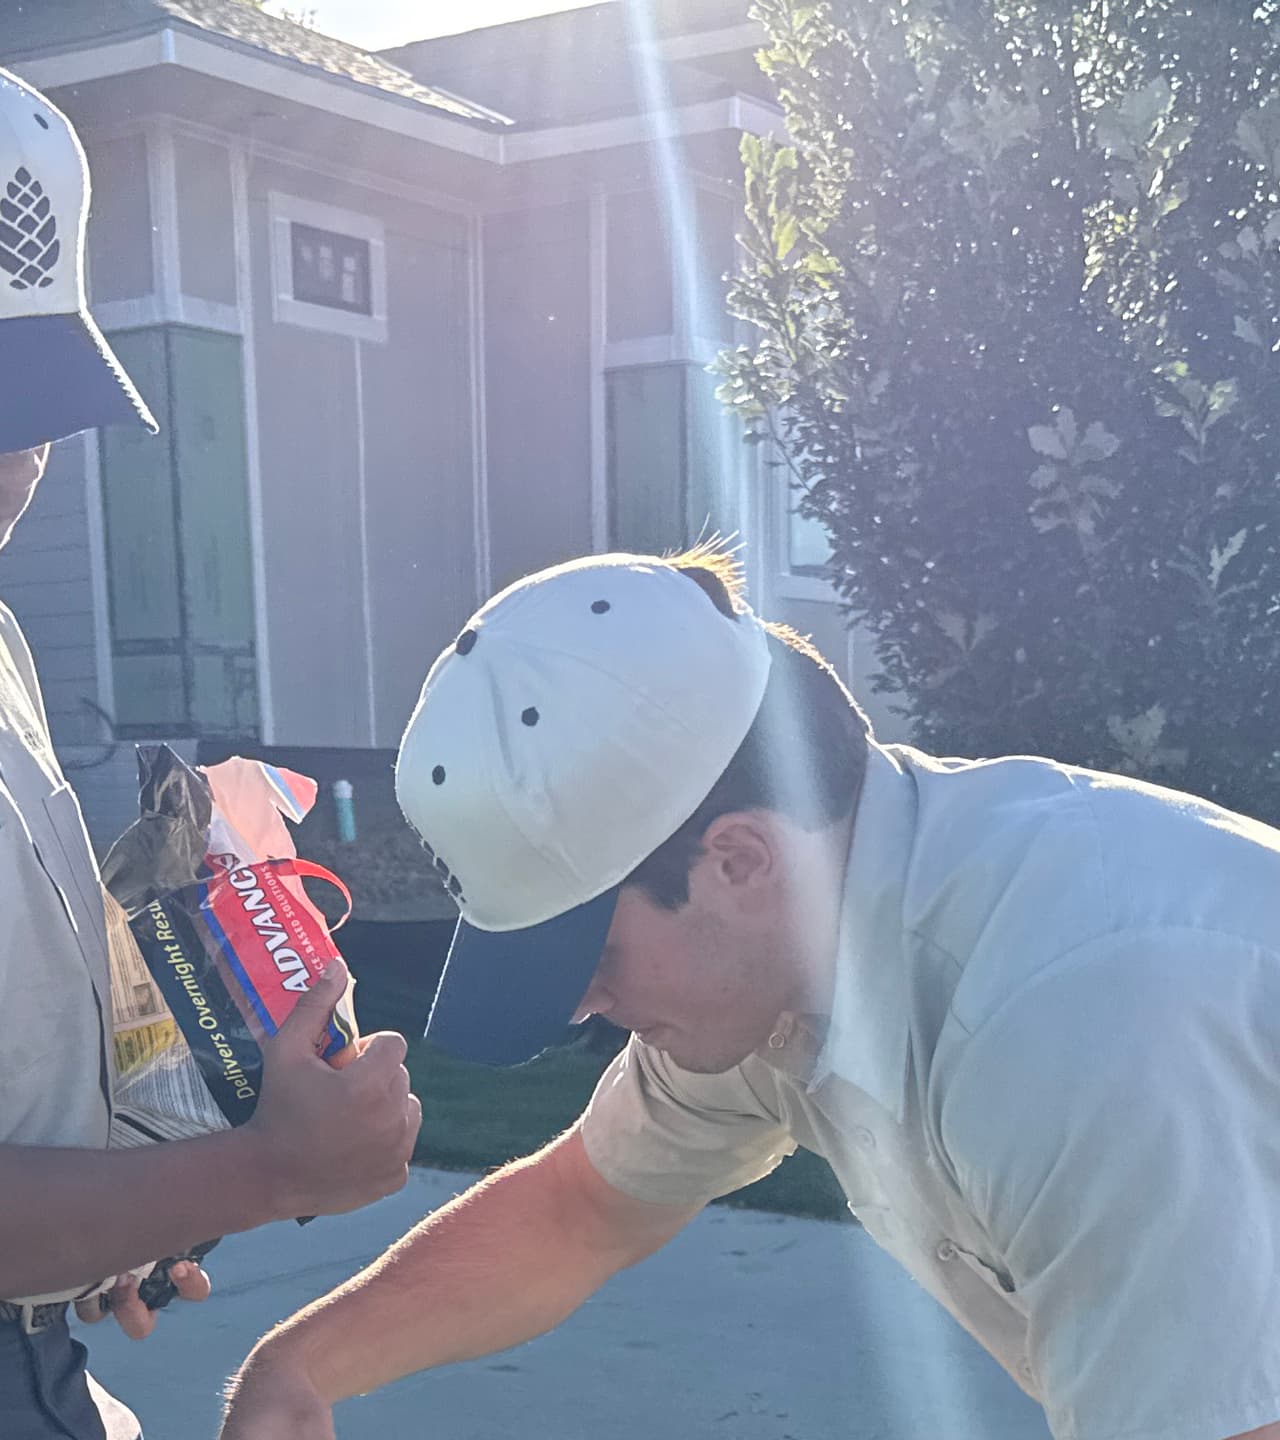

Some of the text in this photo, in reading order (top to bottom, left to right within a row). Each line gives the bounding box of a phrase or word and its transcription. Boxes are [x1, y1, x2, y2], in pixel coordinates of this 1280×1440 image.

[213, 854, 311, 993] ADVANC
[260, 865, 296, 918] SOLUTIONS
[147, 899, 256, 1100] Delivers Overnight Resu
